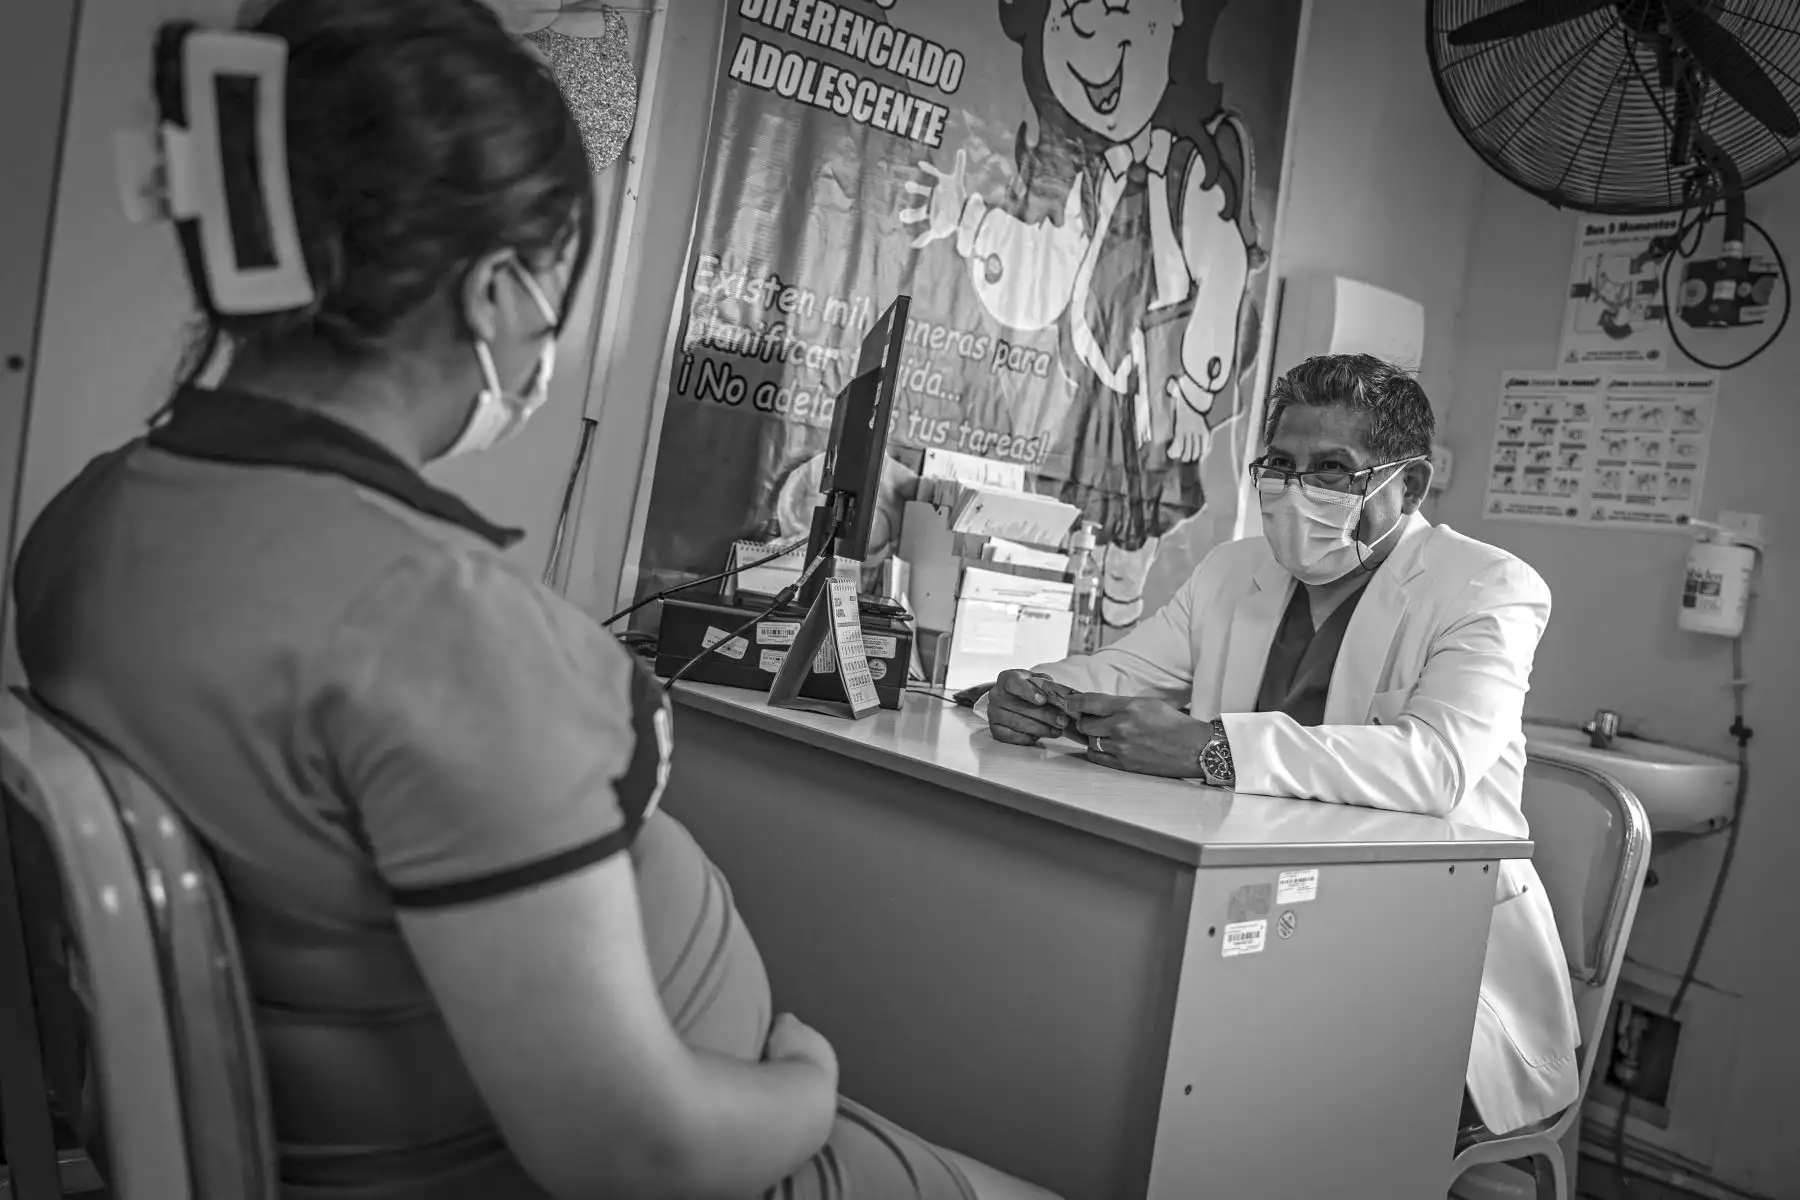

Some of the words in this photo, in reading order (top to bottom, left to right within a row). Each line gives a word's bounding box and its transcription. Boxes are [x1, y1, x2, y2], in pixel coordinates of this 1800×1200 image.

[728, 33, 949, 149] ADOLESCENTE
[692, 253, 816, 317] Existen
[904, 317, 990, 361] neras
[991, 337, 1052, 378] para
[694, 357, 749, 407] No
[908, 408, 951, 444] tus
